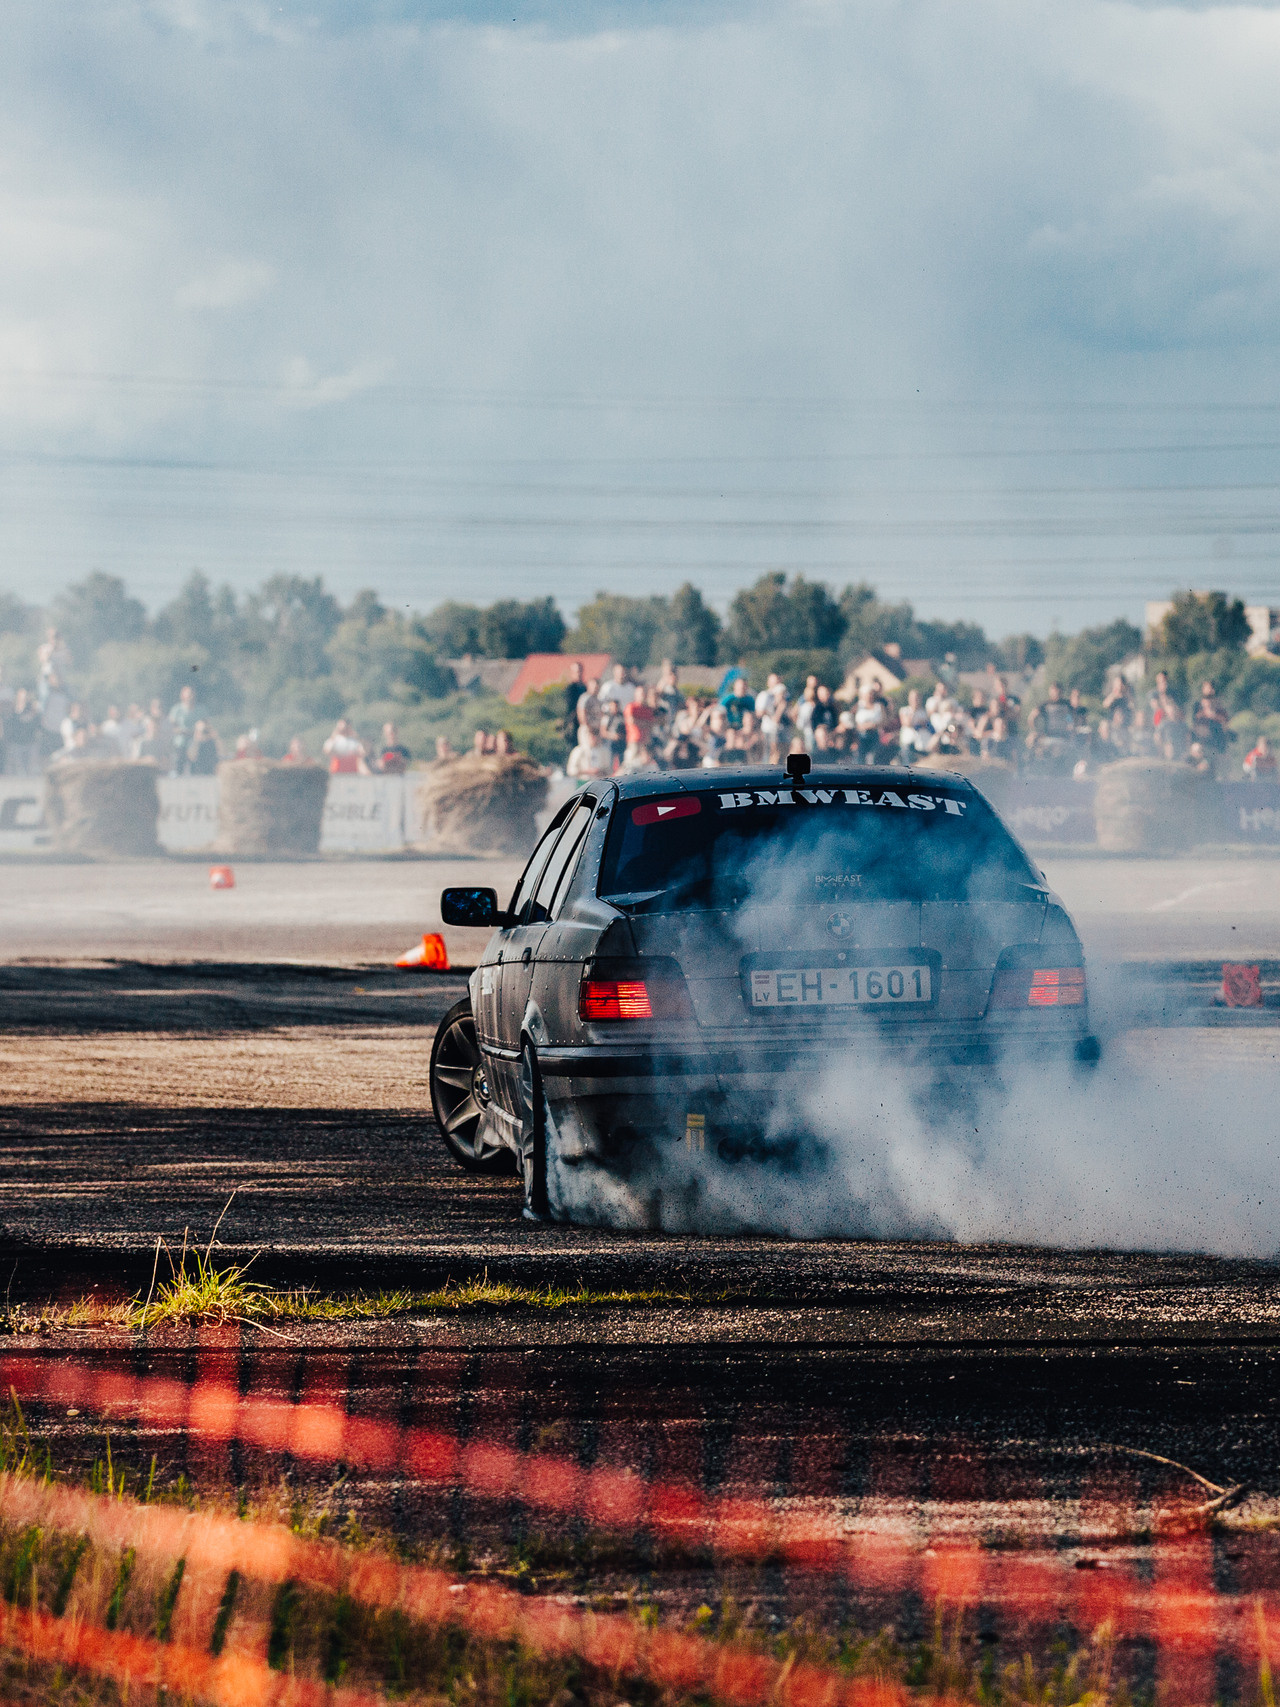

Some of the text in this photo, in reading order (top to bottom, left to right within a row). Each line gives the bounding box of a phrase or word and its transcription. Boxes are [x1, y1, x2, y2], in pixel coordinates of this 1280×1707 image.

[717, 788, 967, 816] BMWEAST
[755, 992, 770, 1002] LV
[776, 969, 922, 1003] EH-1601
